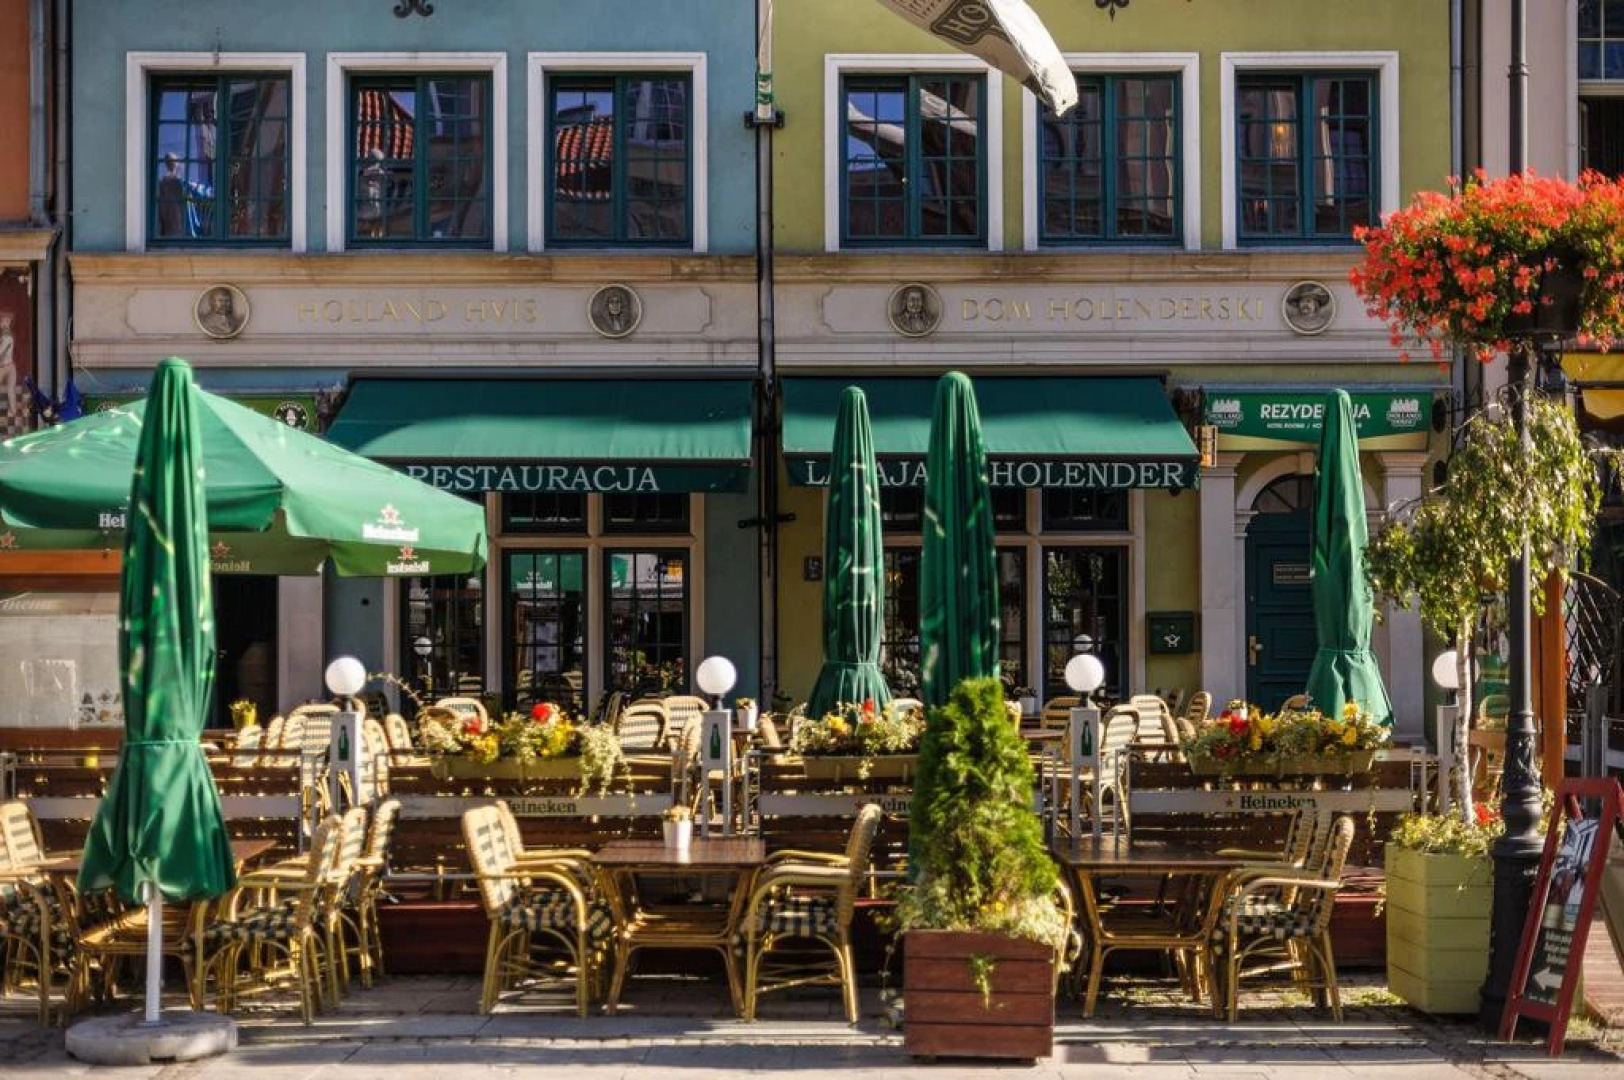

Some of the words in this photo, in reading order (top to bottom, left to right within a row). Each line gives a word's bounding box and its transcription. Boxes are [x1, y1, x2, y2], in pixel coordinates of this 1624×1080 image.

[296, 298, 448, 323] HOLLAND
[962, 298, 1032, 321] DOM
[1050, 297, 1264, 321] HOLENDERSKI
[1260, 404, 1371, 419] REZYDEJA
[990, 461, 1185, 486] HOLENDER
